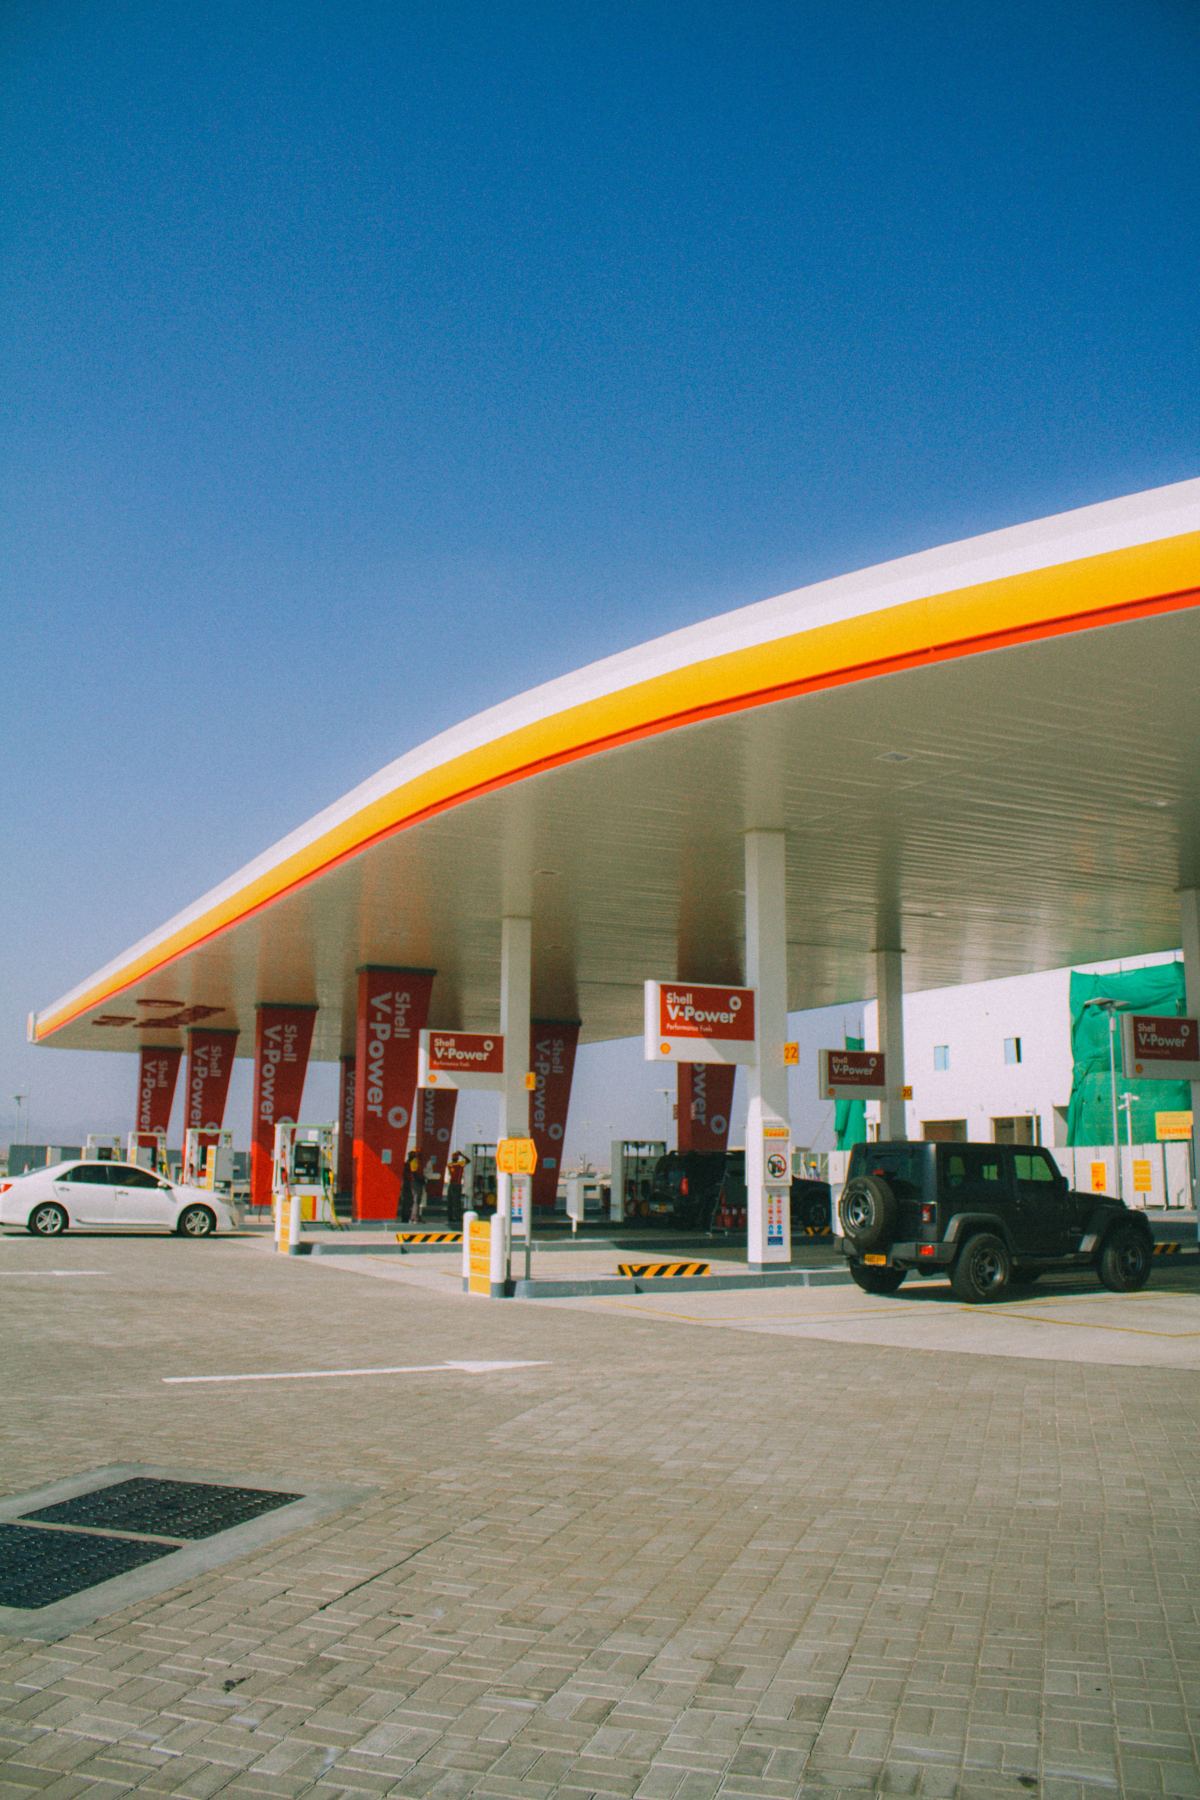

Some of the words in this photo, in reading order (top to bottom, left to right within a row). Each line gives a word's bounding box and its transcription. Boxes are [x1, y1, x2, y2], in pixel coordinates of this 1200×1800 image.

[666, 992, 693, 1005] Shell
[666, 1004, 736, 1024] V-Power
[394, 991, 411, 1039] Shell
[1137, 1023, 1156, 1033] Shell
[283, 1024, 298, 1062] Shell
[367, 992, 392, 1118] V-Power
[434, 1038, 456, 1048] Shell
[434, 1047, 490, 1061] V-Power
[552, 1038, 564, 1074] Shell
[784, 1046, 797, 1059] 22
[1138, 1033, 1187, 1048] V-Power
[157, 1060, 168, 1088] Shell
[210, 1045, 222, 1077] Shell
[260, 1025, 282, 1125] V-Power
[832, 1056, 848, 1064] Shell
[832, 1064, 874, 1076] V-Power
[141, 1060, 157, 1133] V-Power
[191, 1046, 208, 1129] V-Power
[534, 1038, 550, 1132] V-Power
[694, 1063, 706, 1126] ower
[424, 1088, 435, 1135] ower
